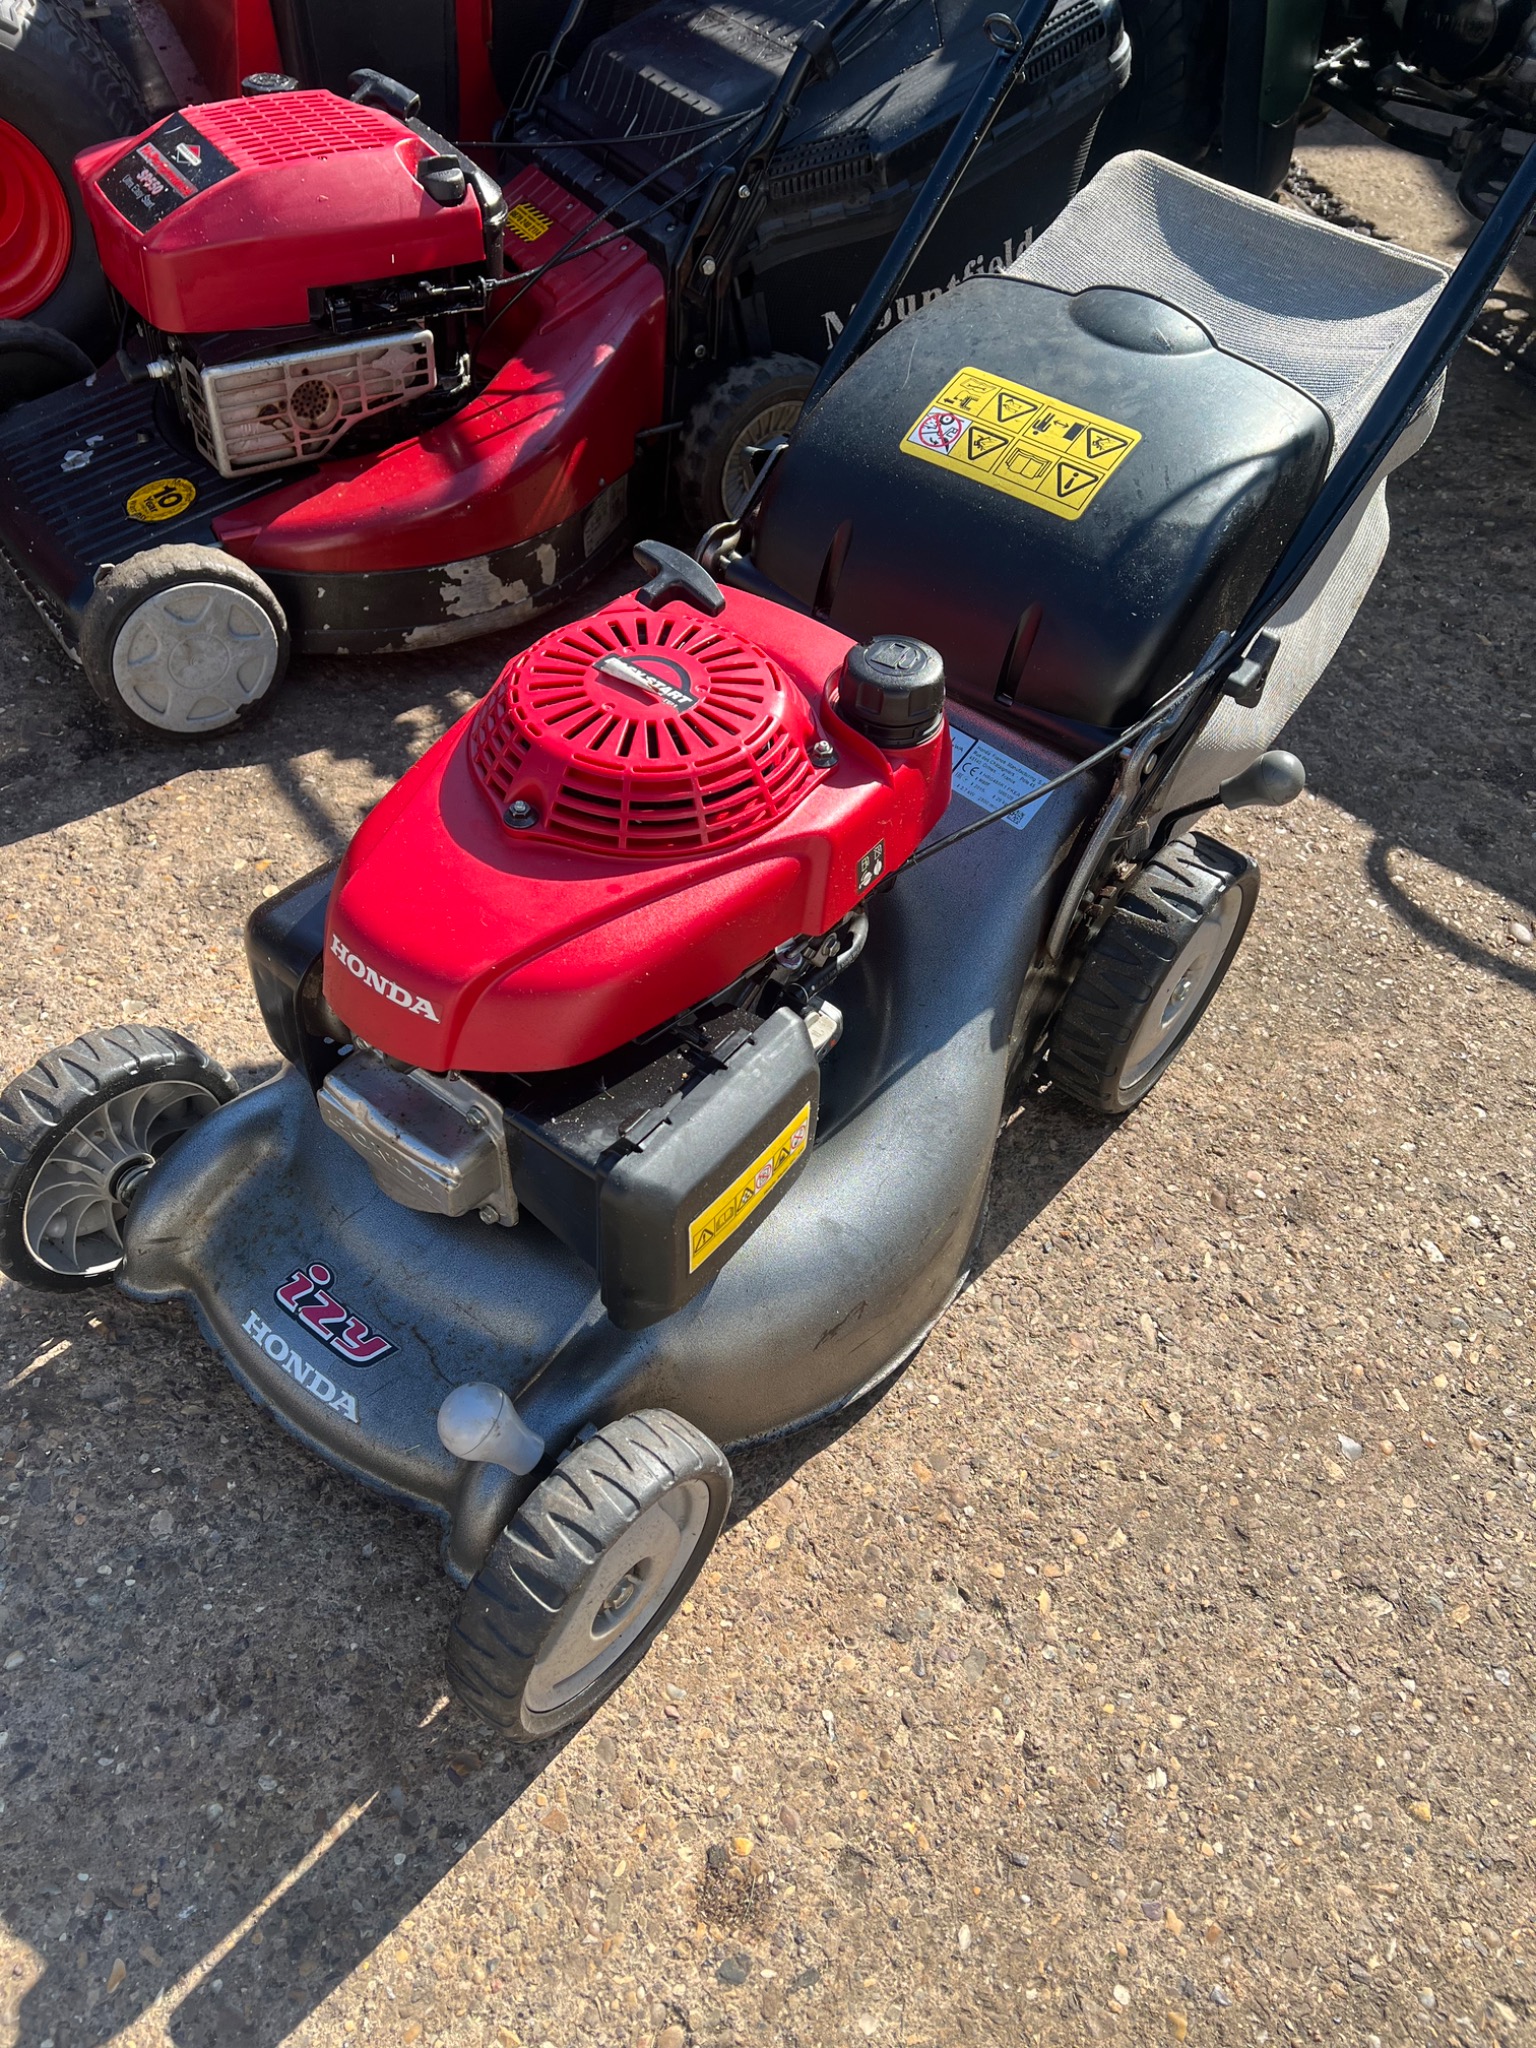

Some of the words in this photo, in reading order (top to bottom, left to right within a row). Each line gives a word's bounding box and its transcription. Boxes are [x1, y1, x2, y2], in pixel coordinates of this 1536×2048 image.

[136, 169, 164, 195] SP550
[130, 183, 145, 200] Easy
[141, 194, 156, 209] Start
[144, 496, 159, 513] Year
[153, 485, 184, 509] 10
[962, 762, 980, 777] CE
[330, 933, 441, 1024] HONDA
[276, 1263, 394, 1362] izzy
[241, 1309, 359, 1424] HONDA
